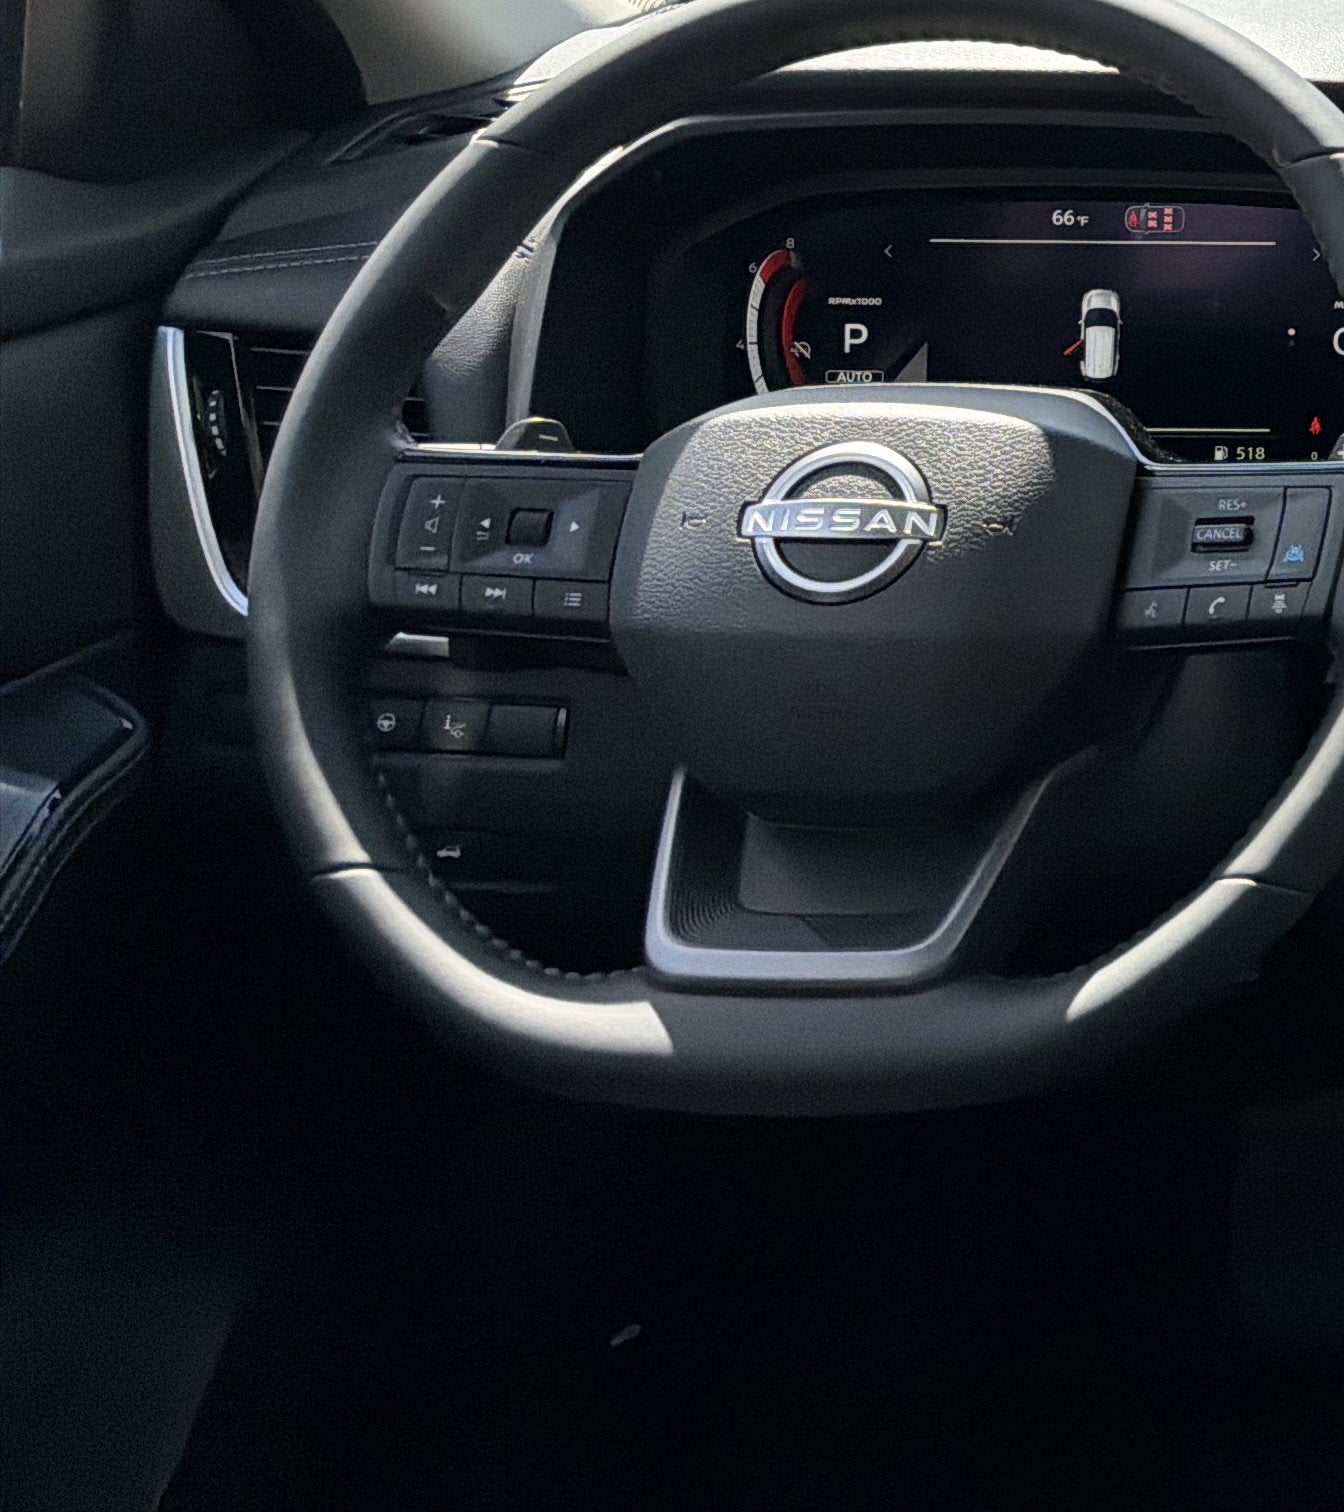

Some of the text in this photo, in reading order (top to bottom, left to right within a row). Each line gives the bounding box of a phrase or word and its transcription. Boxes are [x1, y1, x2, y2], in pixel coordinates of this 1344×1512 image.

[786, 238, 795, 248] 8
[749, 262, 758, 273] 6
[736, 339, 745, 350] 4
[844, 323, 868, 354] P
[836, 371, 873, 383] AUTO
[1236, 447, 1265, 460] 518
[746, 507, 938, 536] NISSAN
[1196, 527, 1243, 540] CANCEL
[512, 553, 534, 564] OK
